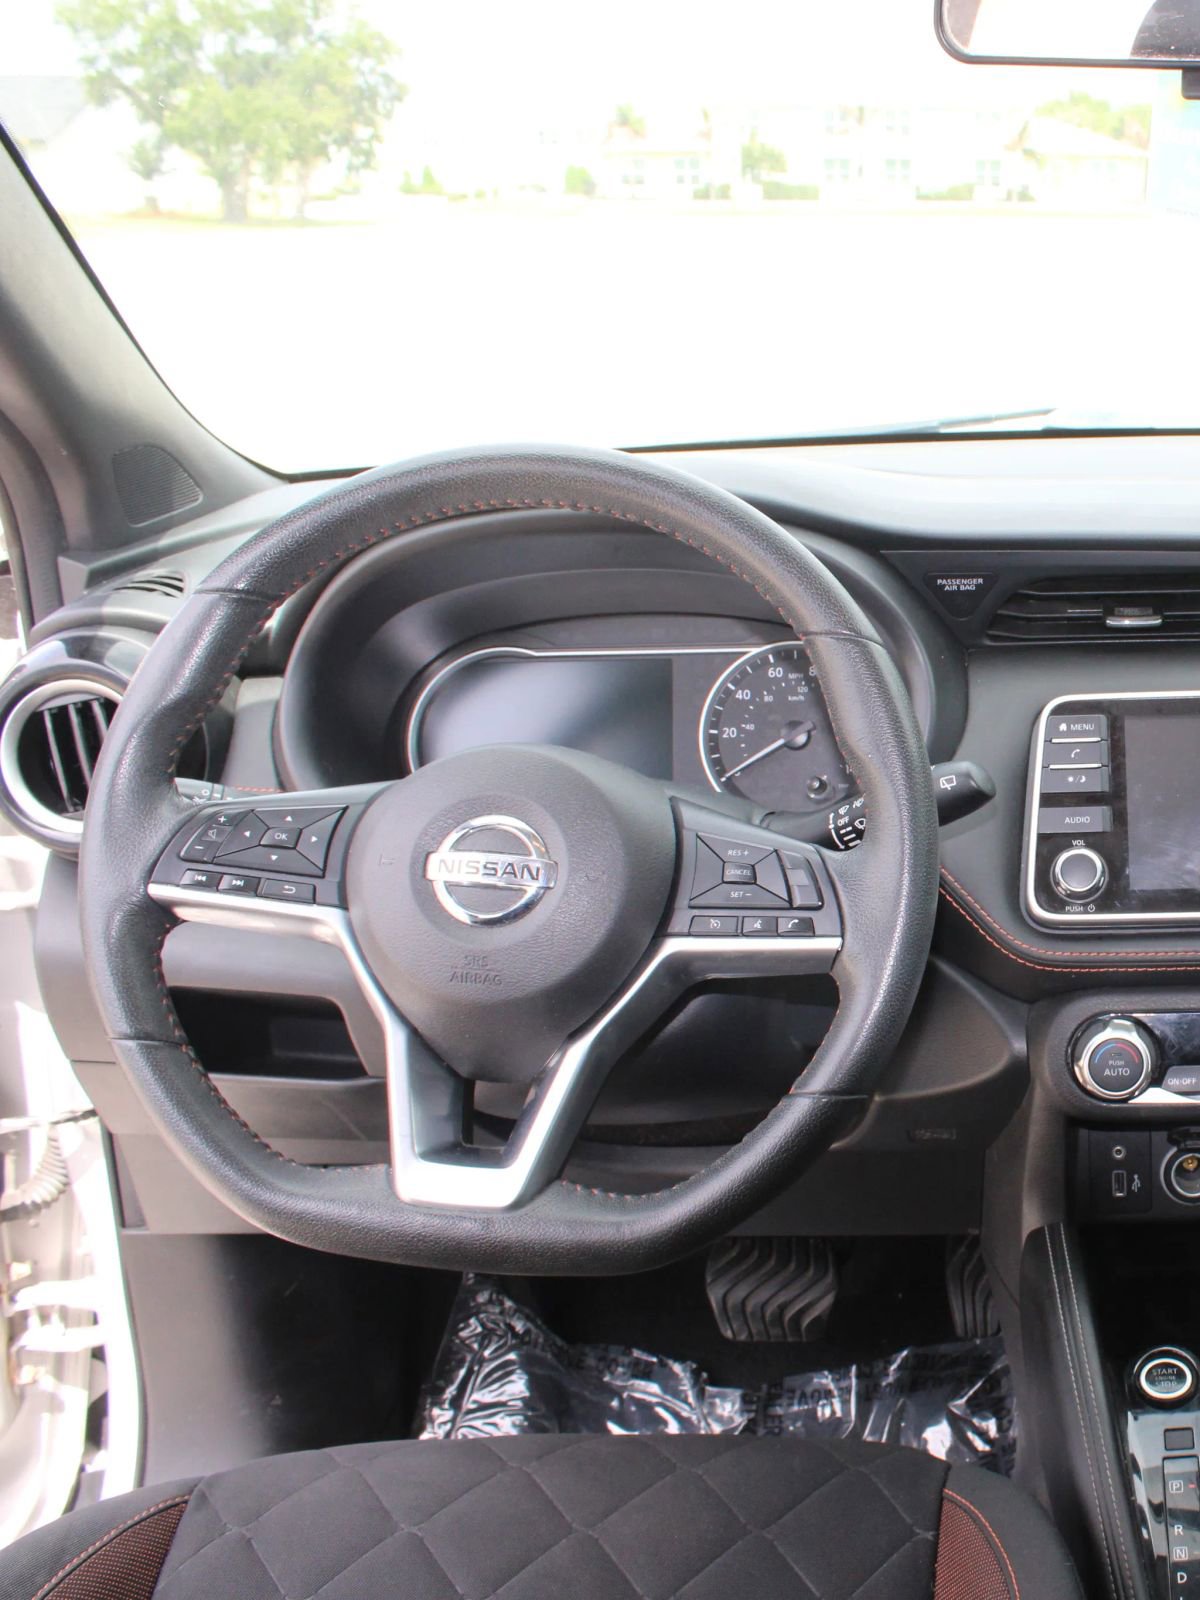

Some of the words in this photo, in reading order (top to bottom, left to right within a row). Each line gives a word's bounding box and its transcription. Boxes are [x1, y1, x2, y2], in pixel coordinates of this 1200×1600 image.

[937, 577, 984, 586] PASSENGER
[768, 667, 784, 678] 60
[788, 672, 804, 680] MPH
[735, 689, 751, 701] 40
[788, 694, 805, 702] km/h
[1070, 723, 1095, 731] MENU
[722, 727, 737, 738] 20
[837, 816, 849, 827] OFF
[1064, 816, 1091, 824] AUDIO
[274, 832, 288, 841] OK
[438, 858, 542, 881] NISSAN
[726, 868, 752, 876] CANCEL
[449, 971, 503, 985] AIRBAG
[1103, 1067, 1130, 1077] AUTO
[1152, 1367, 1178, 1376] START
[1174, 1524, 1184, 1536] R
[1176, 1571, 1188, 1584] D
